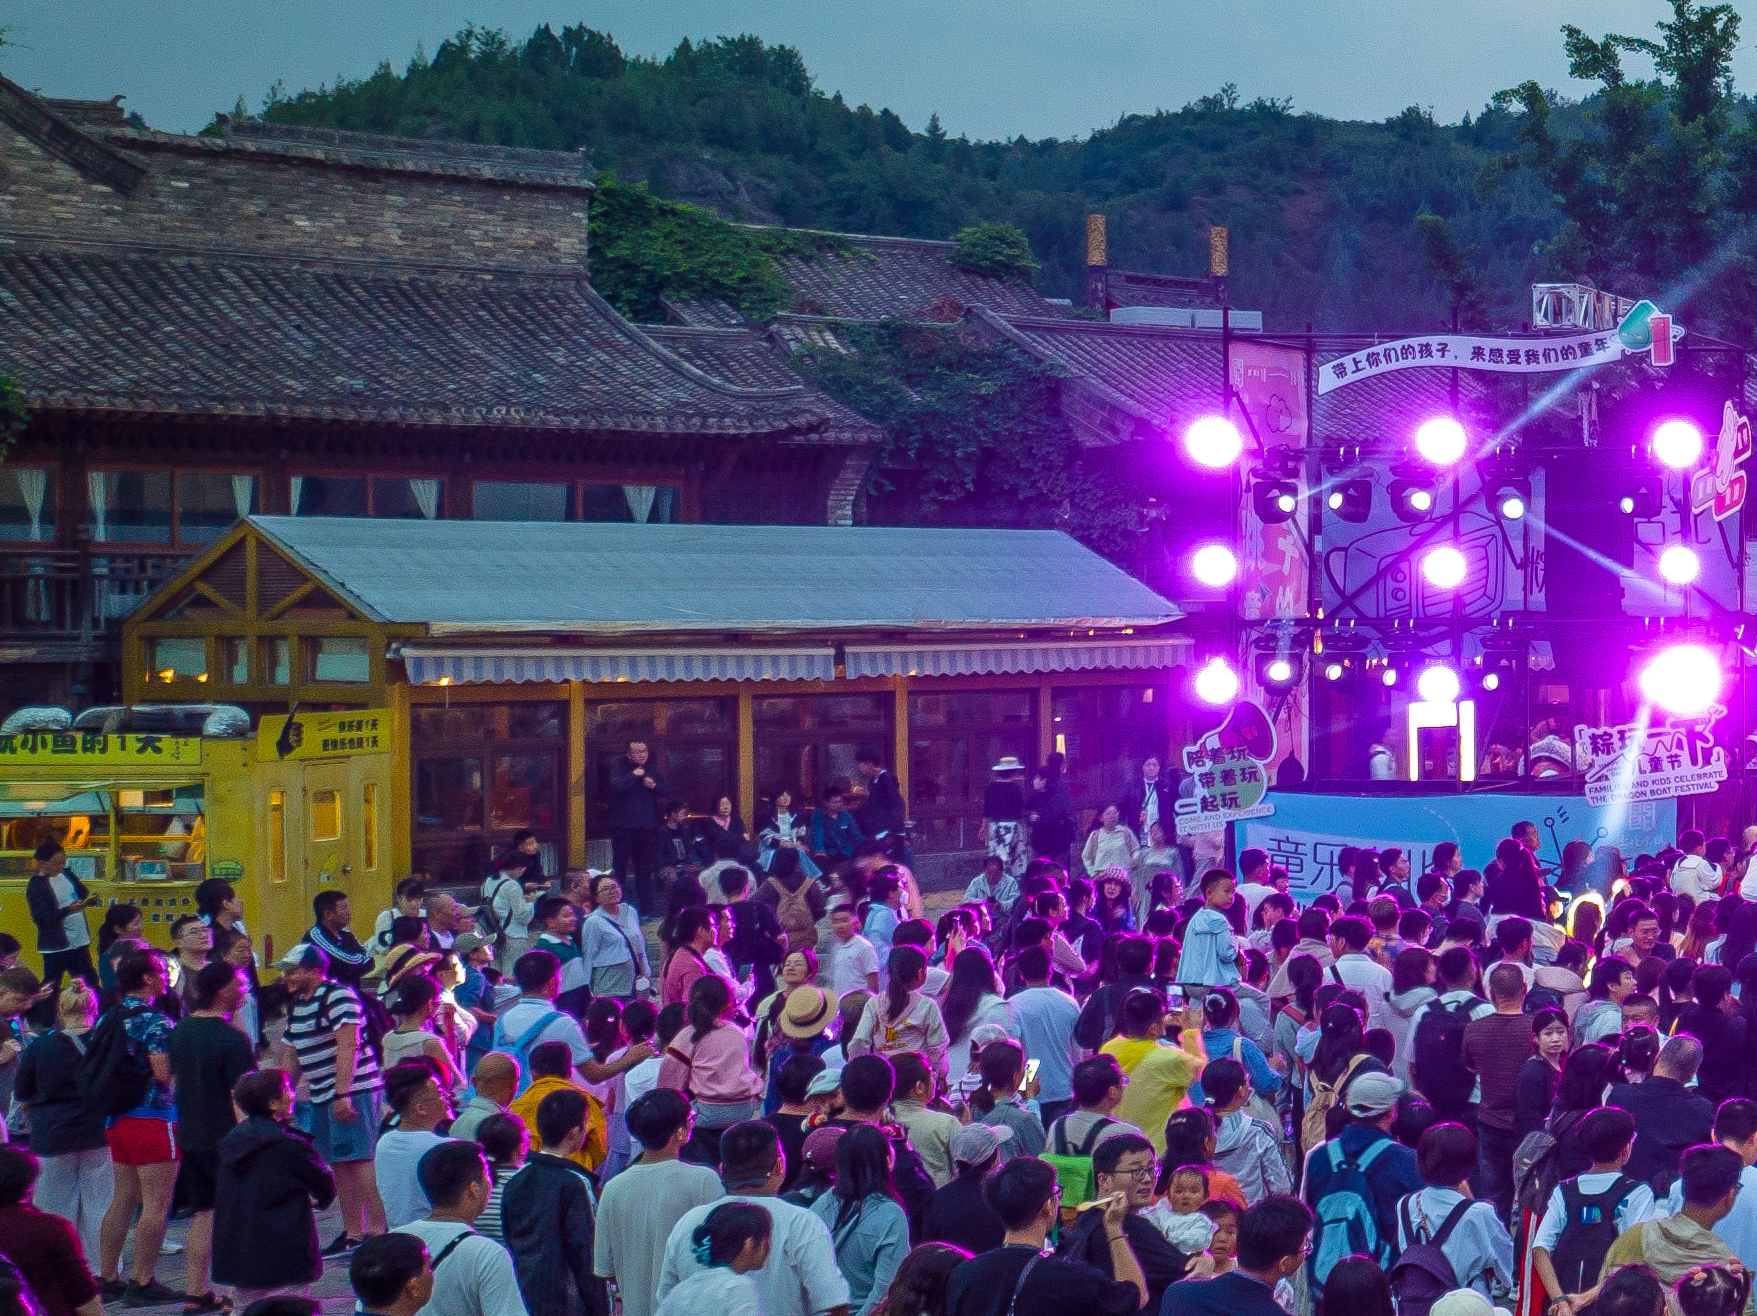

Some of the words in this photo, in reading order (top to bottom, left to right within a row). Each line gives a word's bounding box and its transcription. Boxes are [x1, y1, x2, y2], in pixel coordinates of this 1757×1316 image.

[1651, 777, 1672, 786] KIDS
[1674, 770, 1725, 784] CELEBRATE
[1650, 786, 1672, 796] BOAT
[1675, 781, 1714, 793] FESTIVAL
